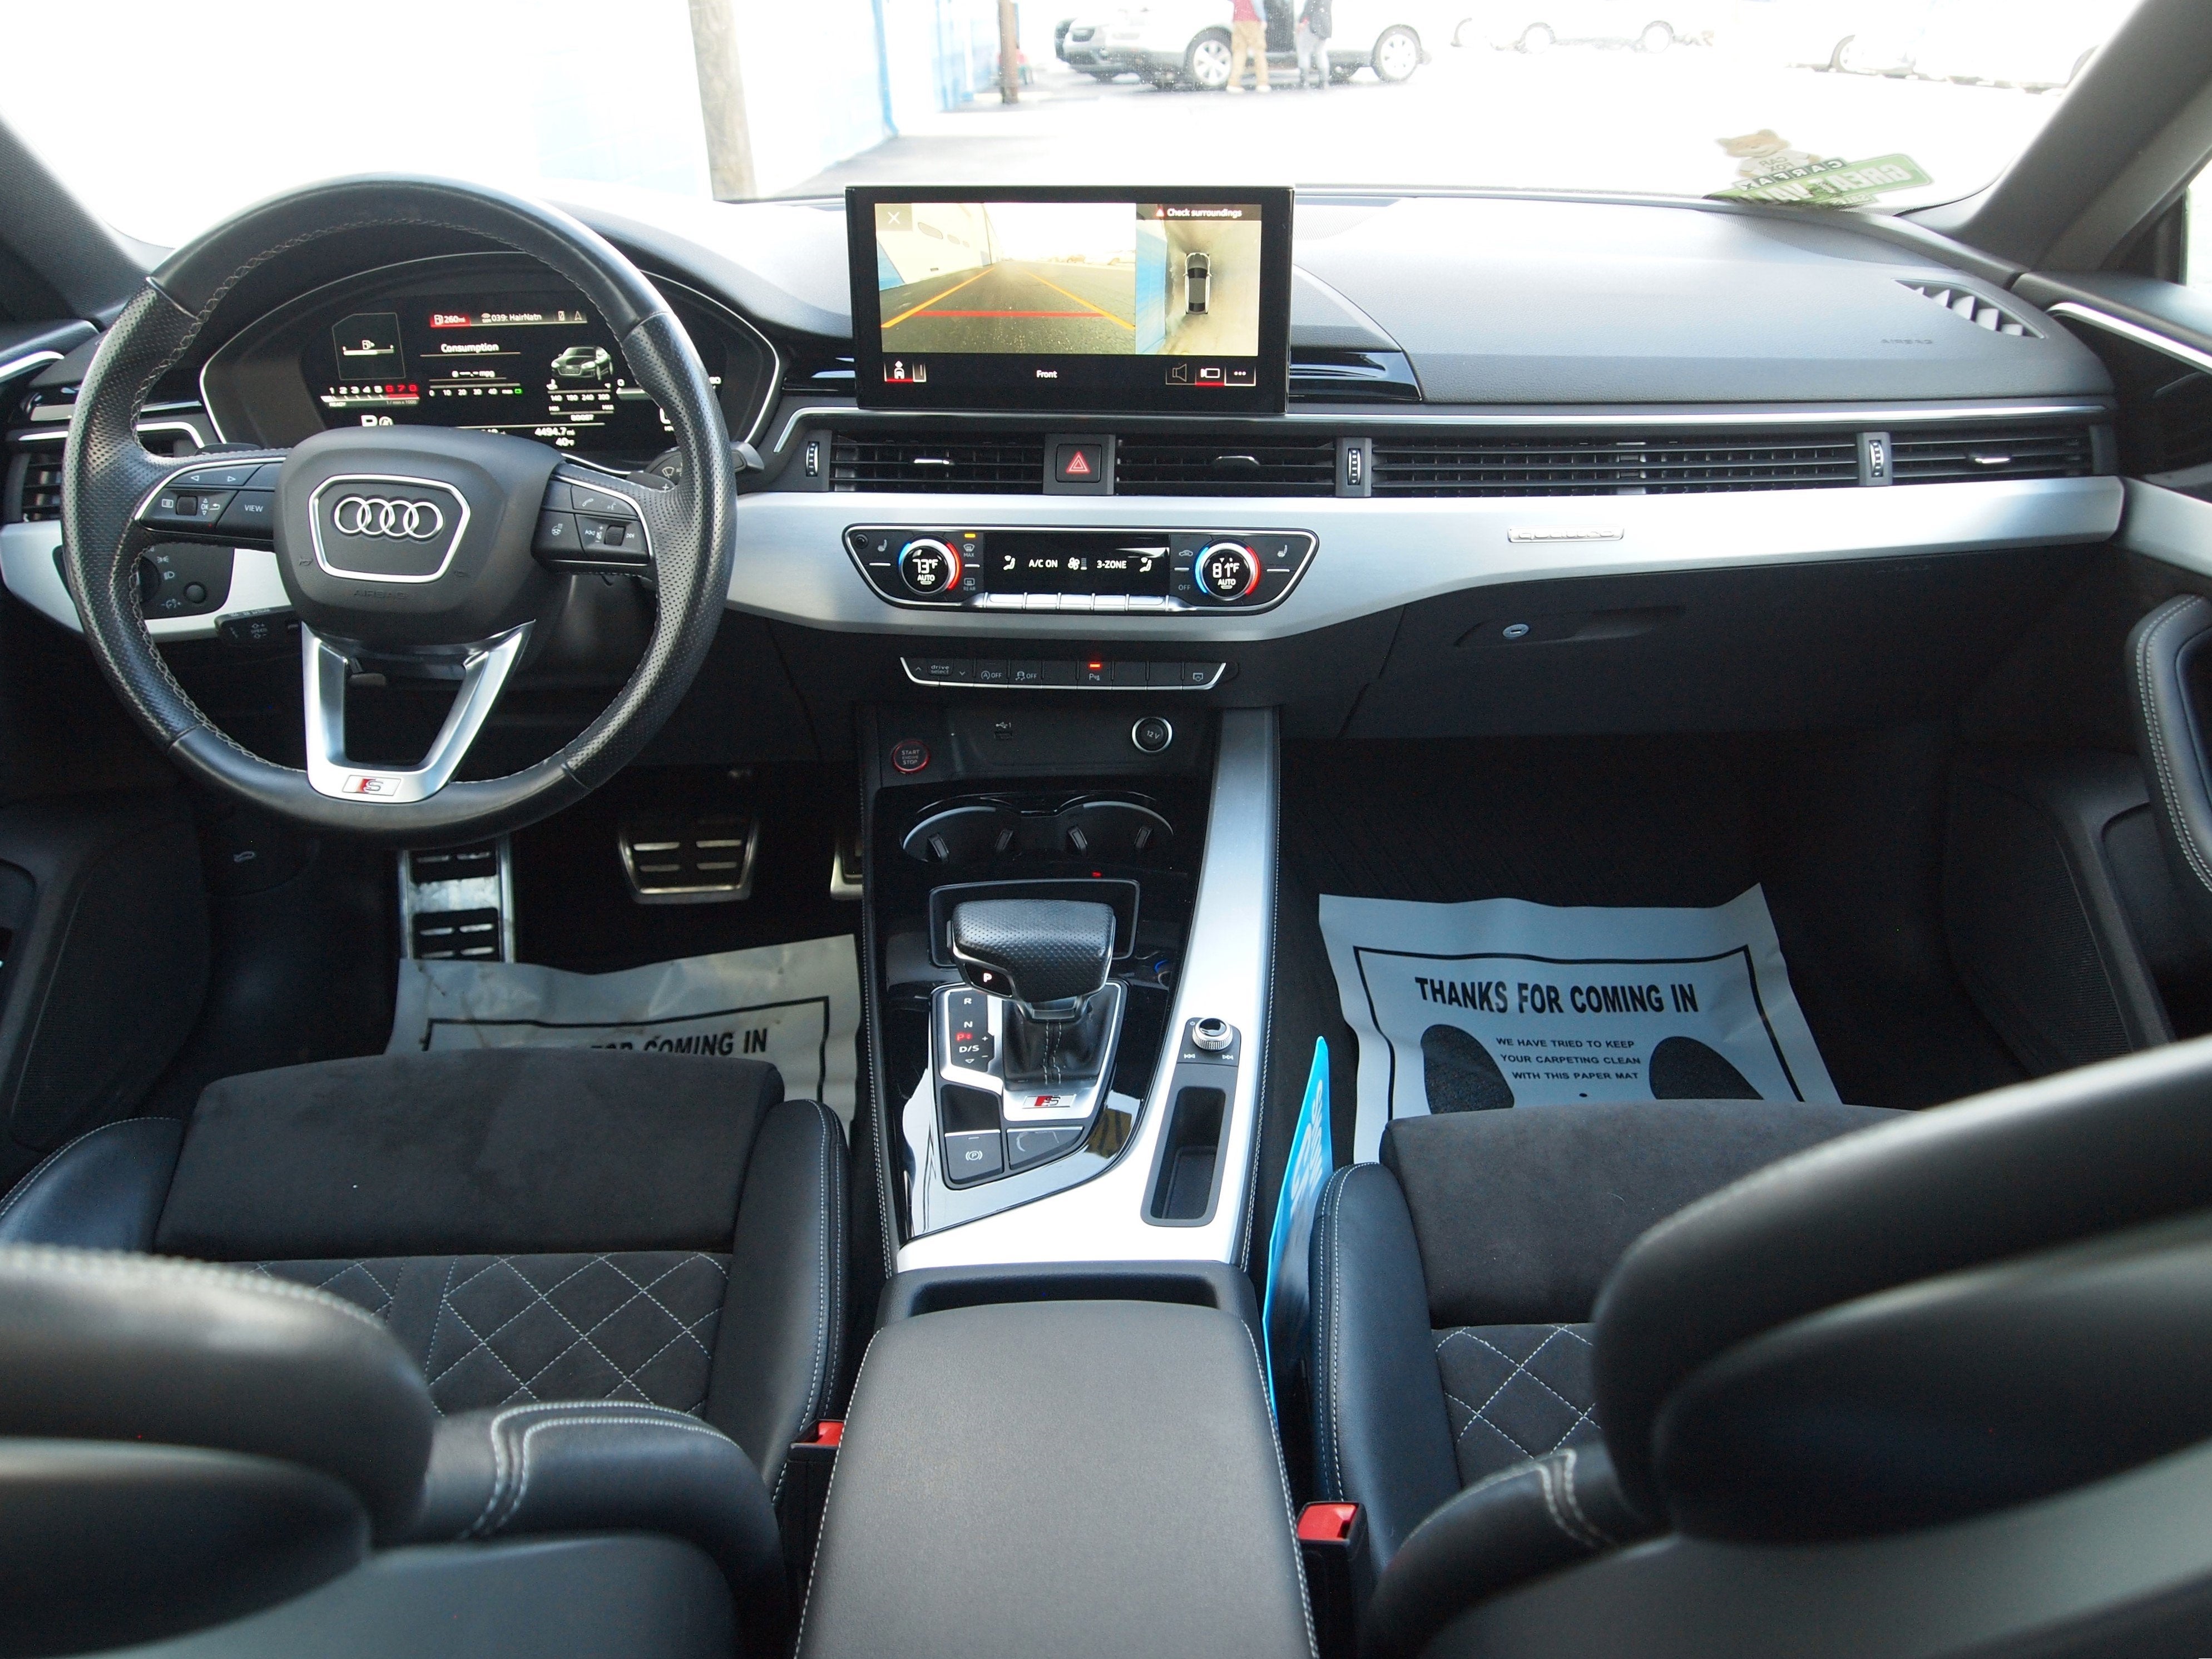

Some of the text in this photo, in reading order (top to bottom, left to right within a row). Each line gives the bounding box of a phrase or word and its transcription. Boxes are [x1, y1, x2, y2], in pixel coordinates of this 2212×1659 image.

[1167, 208, 1243, 219] Check surroundings
[441, 343, 499, 353] Consumption
[1036, 369, 1058, 378] Front
[244, 504, 264, 512] VIEW
[1028, 559, 1058, 568] A/C ON
[1096, 559, 1127, 569] 3-ZONE
[983, 972, 992, 982] P
[1414, 977, 1699, 1014] THANKS FOR COMING IN
[743, 1027, 768, 1054] IN
[1496, 1037, 1635, 1048] WE HAVE TRIED TO KEEP
[958, 1044, 980, 1053] D/S
[1500, 1053, 1532, 1063] YOUR
